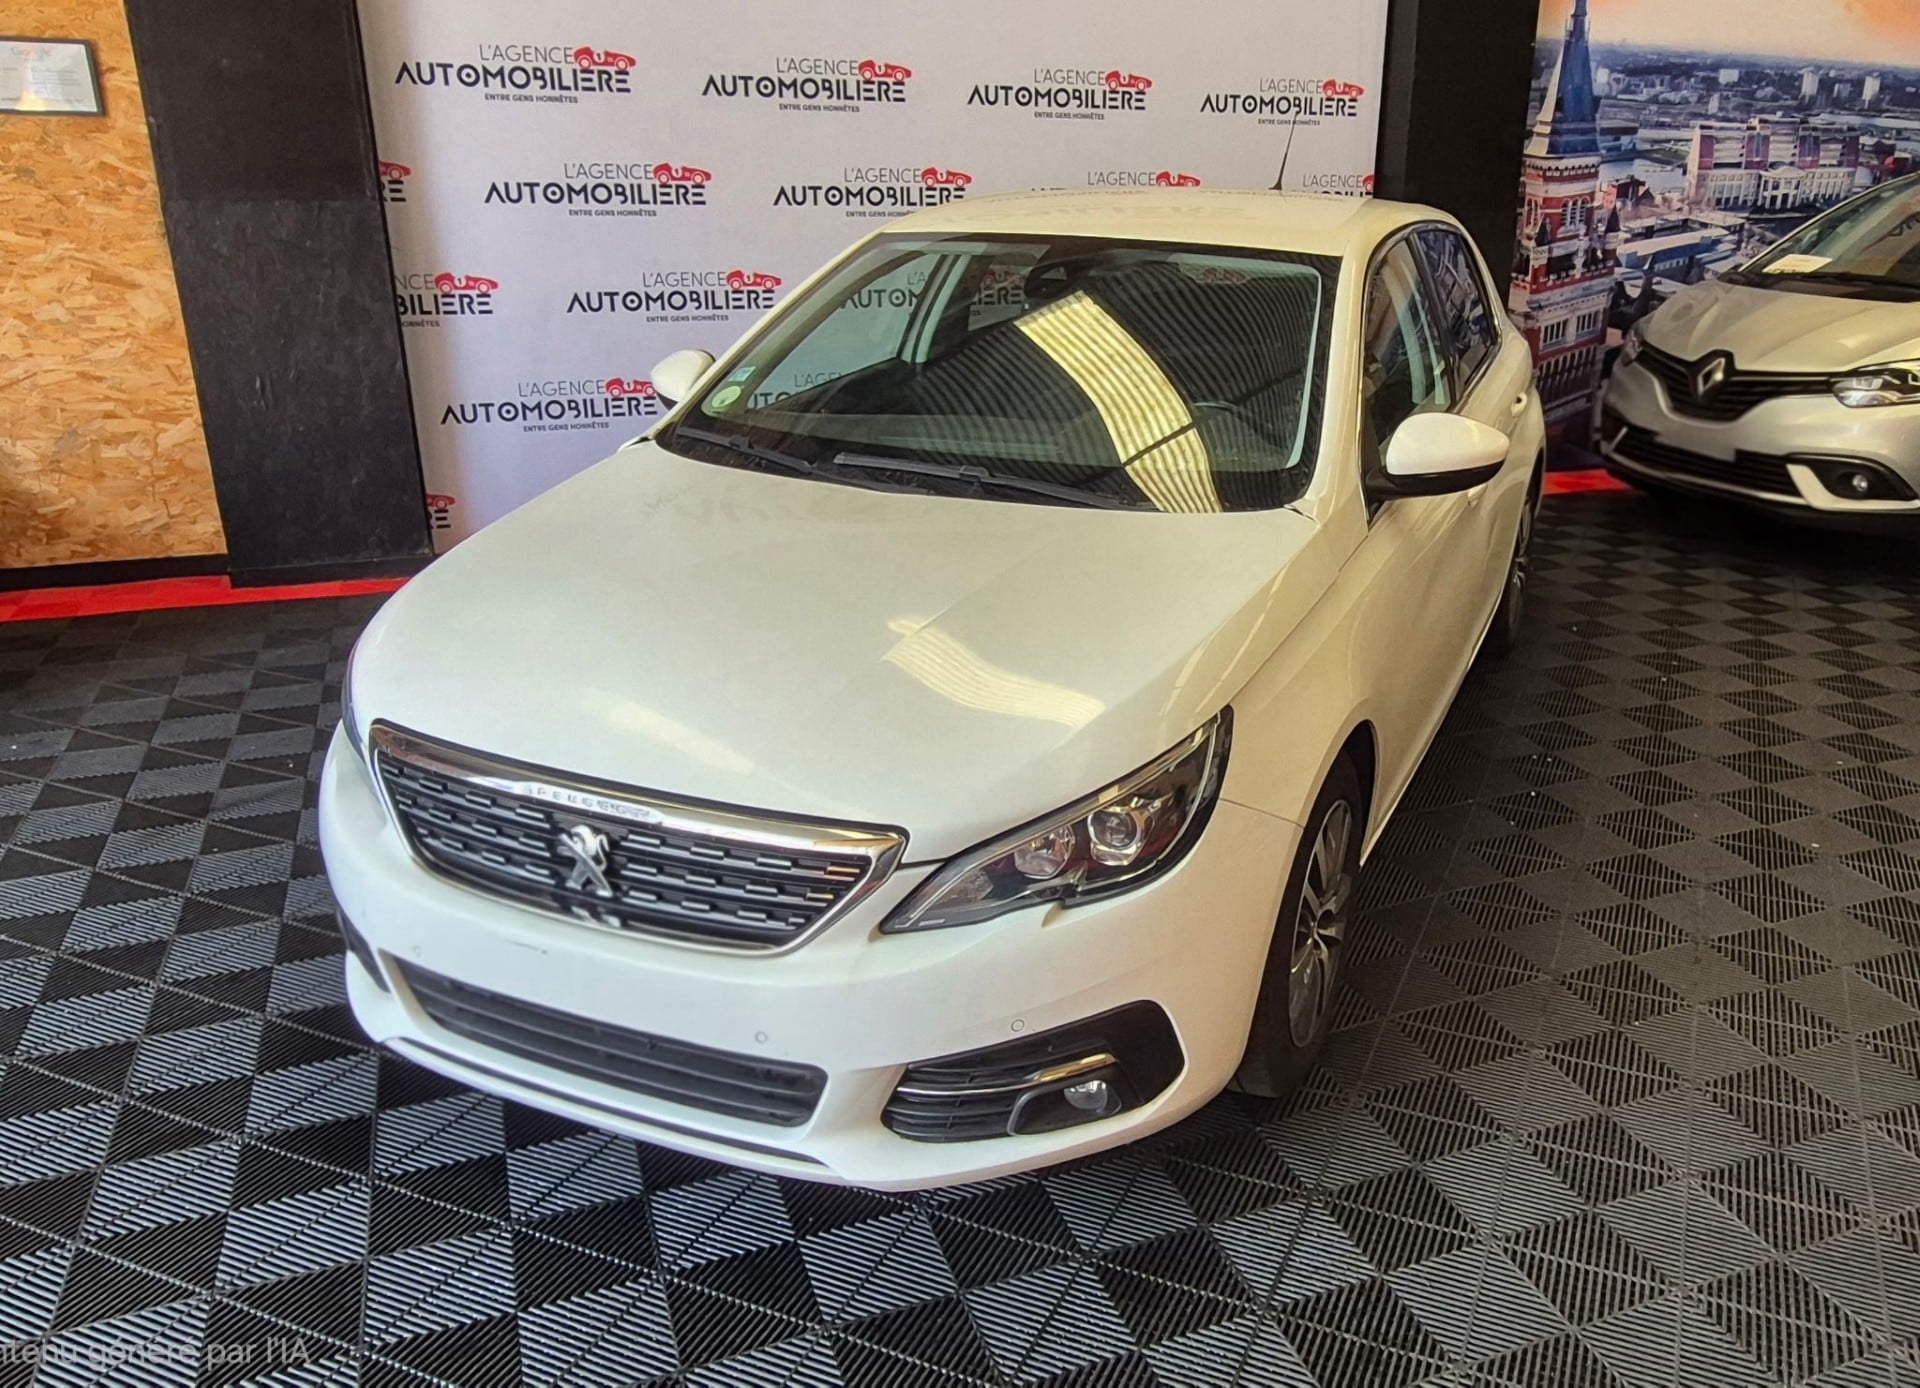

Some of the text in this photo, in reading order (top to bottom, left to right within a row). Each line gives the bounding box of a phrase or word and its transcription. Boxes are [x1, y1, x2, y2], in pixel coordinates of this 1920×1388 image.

[479, 44, 576, 65] L'AGENCE
[776, 57, 859, 76] L'AGENCE
[1033, 68, 1106, 86] L'AGENCE
[1259, 77, 1323, 94] L'AGENCE
[484, 93, 511, 102] ENTRE
[563, 163, 653, 180] L'AGENCE
[844, 167, 921, 184] L'AGENCE
[1087, 171, 1157, 186] L'AGENCE
[1303, 174, 1363, 189] L'AGENCE
[642, 271, 726, 288] L'AGENCE
[518, 379, 606, 398] L'AGENCE
[523, 425, 547, 433] ENTRE
